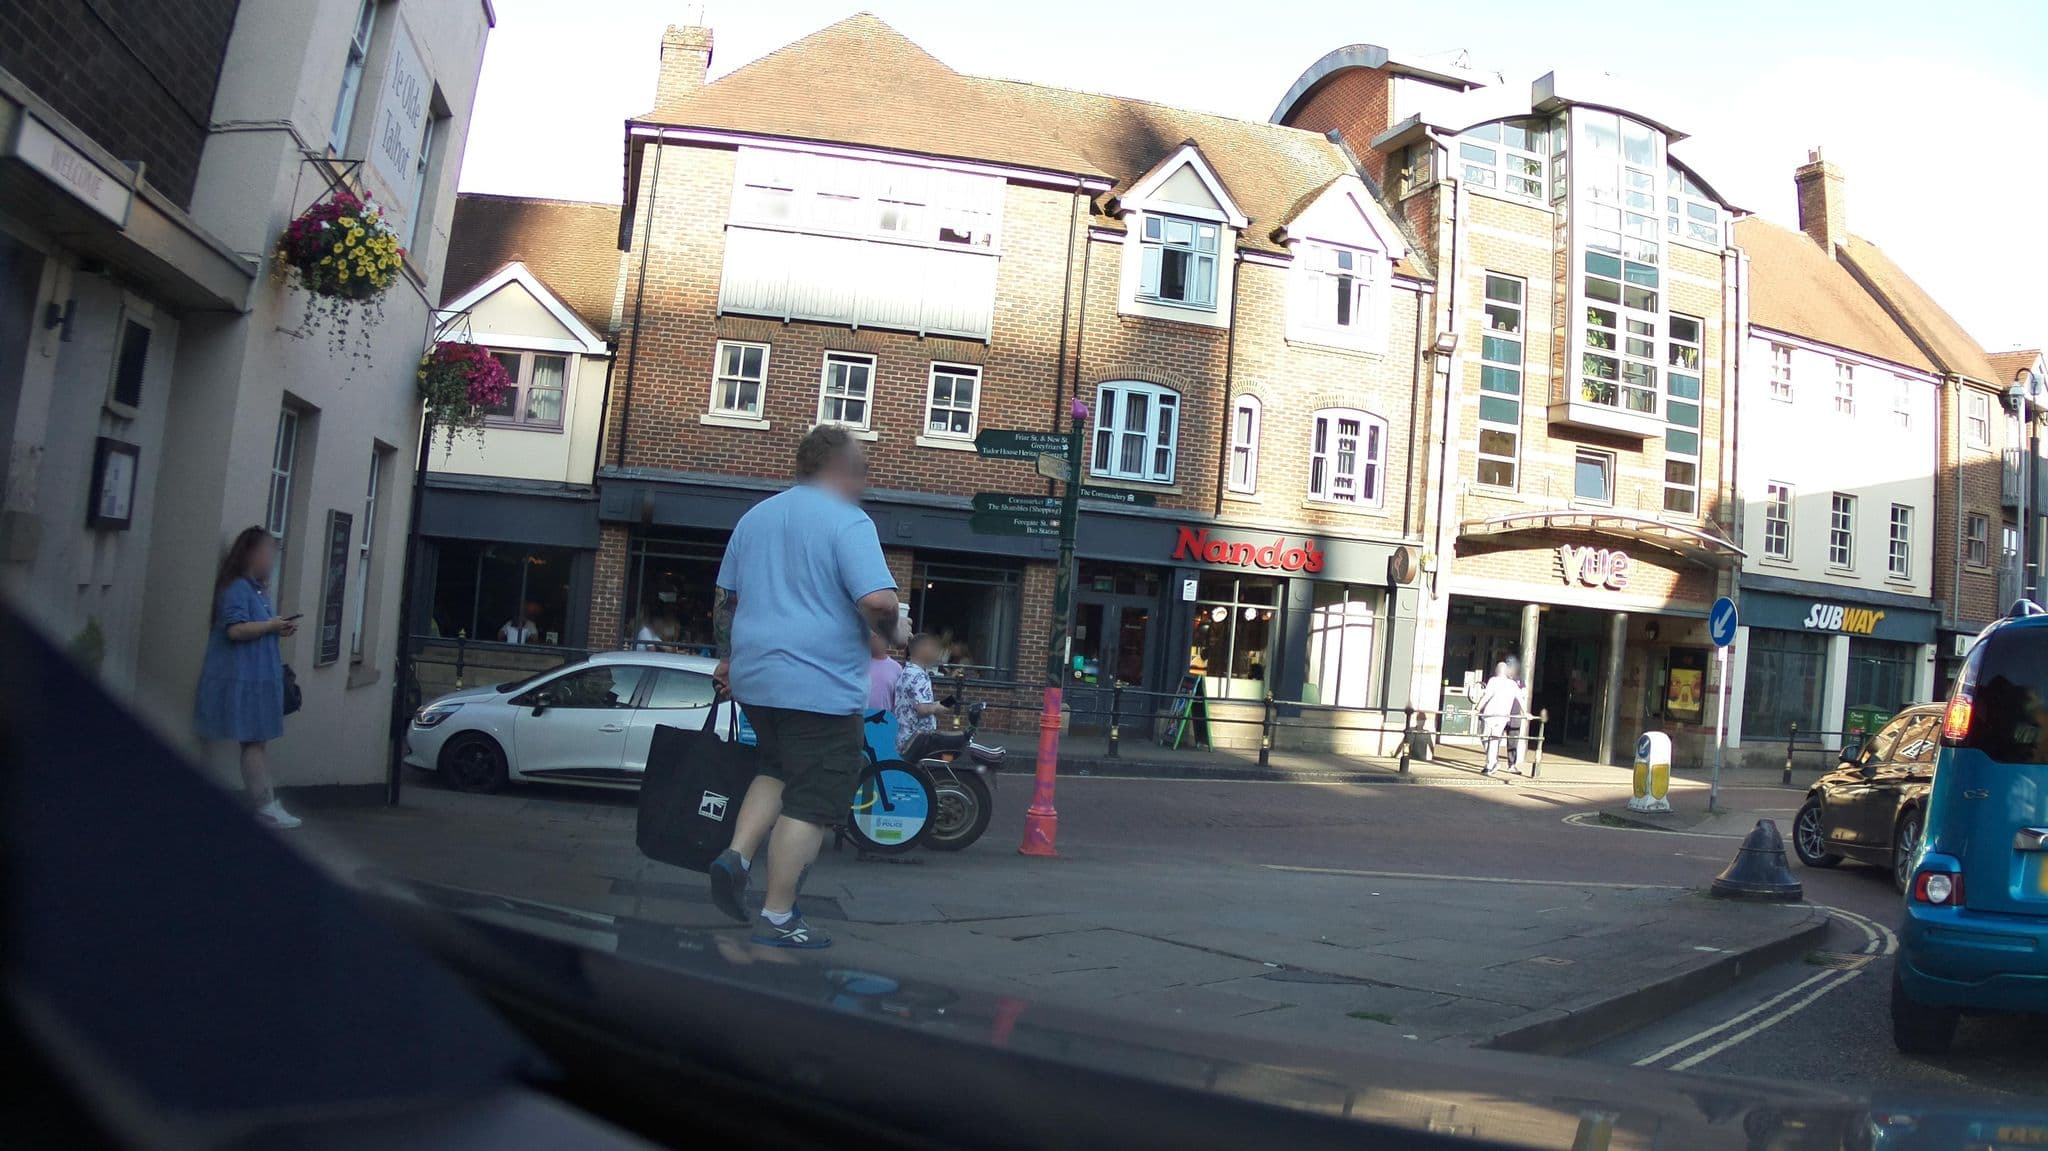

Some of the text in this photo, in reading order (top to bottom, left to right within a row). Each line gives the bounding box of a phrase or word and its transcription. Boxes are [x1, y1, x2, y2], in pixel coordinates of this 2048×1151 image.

[392, 50, 421, 129] Ye Olde
[382, 107, 410, 181] Talbot
[982, 447, 999, 455] Tudor
[999, 448, 1018, 456] House
[1031, 442, 1062, 451] Greyfriars
[1008, 496, 1044, 505] Cornmarket
[1080, 488, 1126, 502] The Commandery
[1001, 504, 1028, 512] Shambles
[1029, 505, 1062, 516] (Shopping)
[1013, 518, 1039, 527] Foregate
[1026, 526, 1060, 535] Bus Station
[1171, 526, 1325, 572] Nando's
[1803, 603, 1885, 634] SUBWAY
